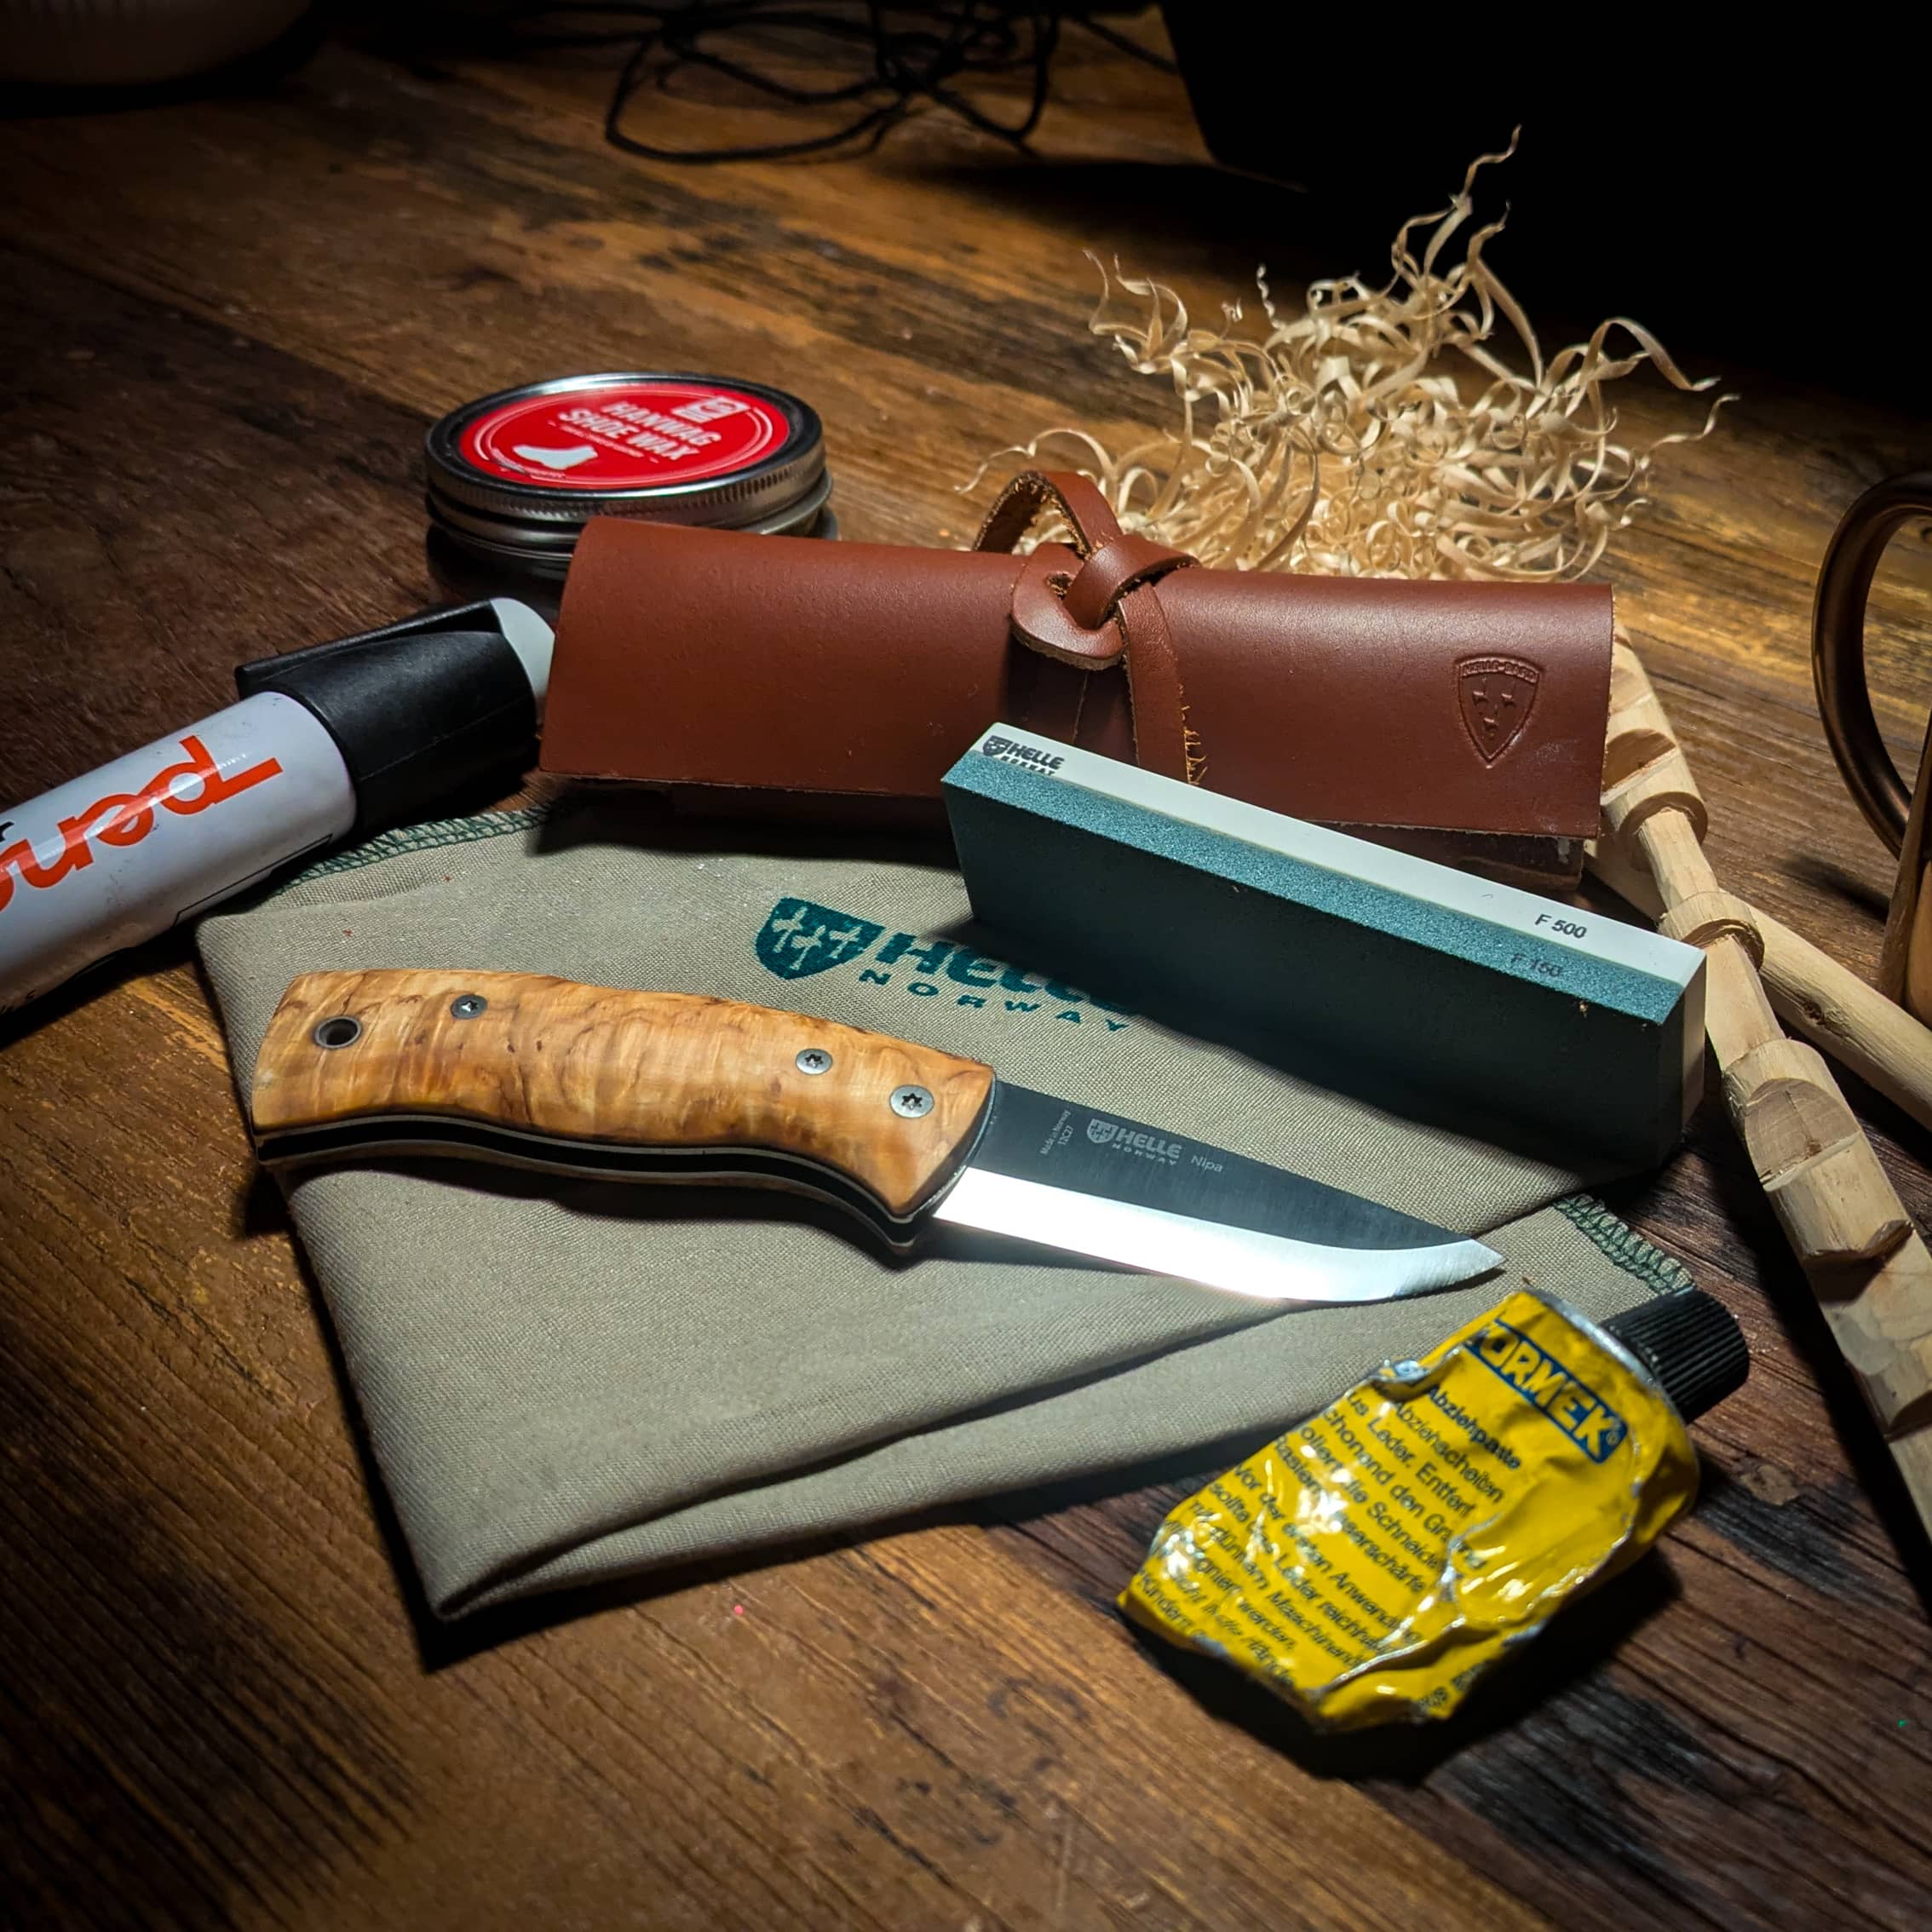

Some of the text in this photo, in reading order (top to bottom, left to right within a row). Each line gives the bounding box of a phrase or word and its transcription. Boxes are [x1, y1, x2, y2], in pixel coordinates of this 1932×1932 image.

[558, 408, 630, 439] SHOE
[628, 429, 701, 461] WAX
[1007, 743, 1065, 770] HELLE
[1535, 913, 1587, 939] F 500
[859, 969, 1130, 1032] NORWAY
[1112, 1143, 1177, 1166] NORWAY
[1115, 1127, 1182, 1159] HELLE
[1191, 1155, 1223, 1173] Nipa
[1388, 1479, 1427, 1519] den
